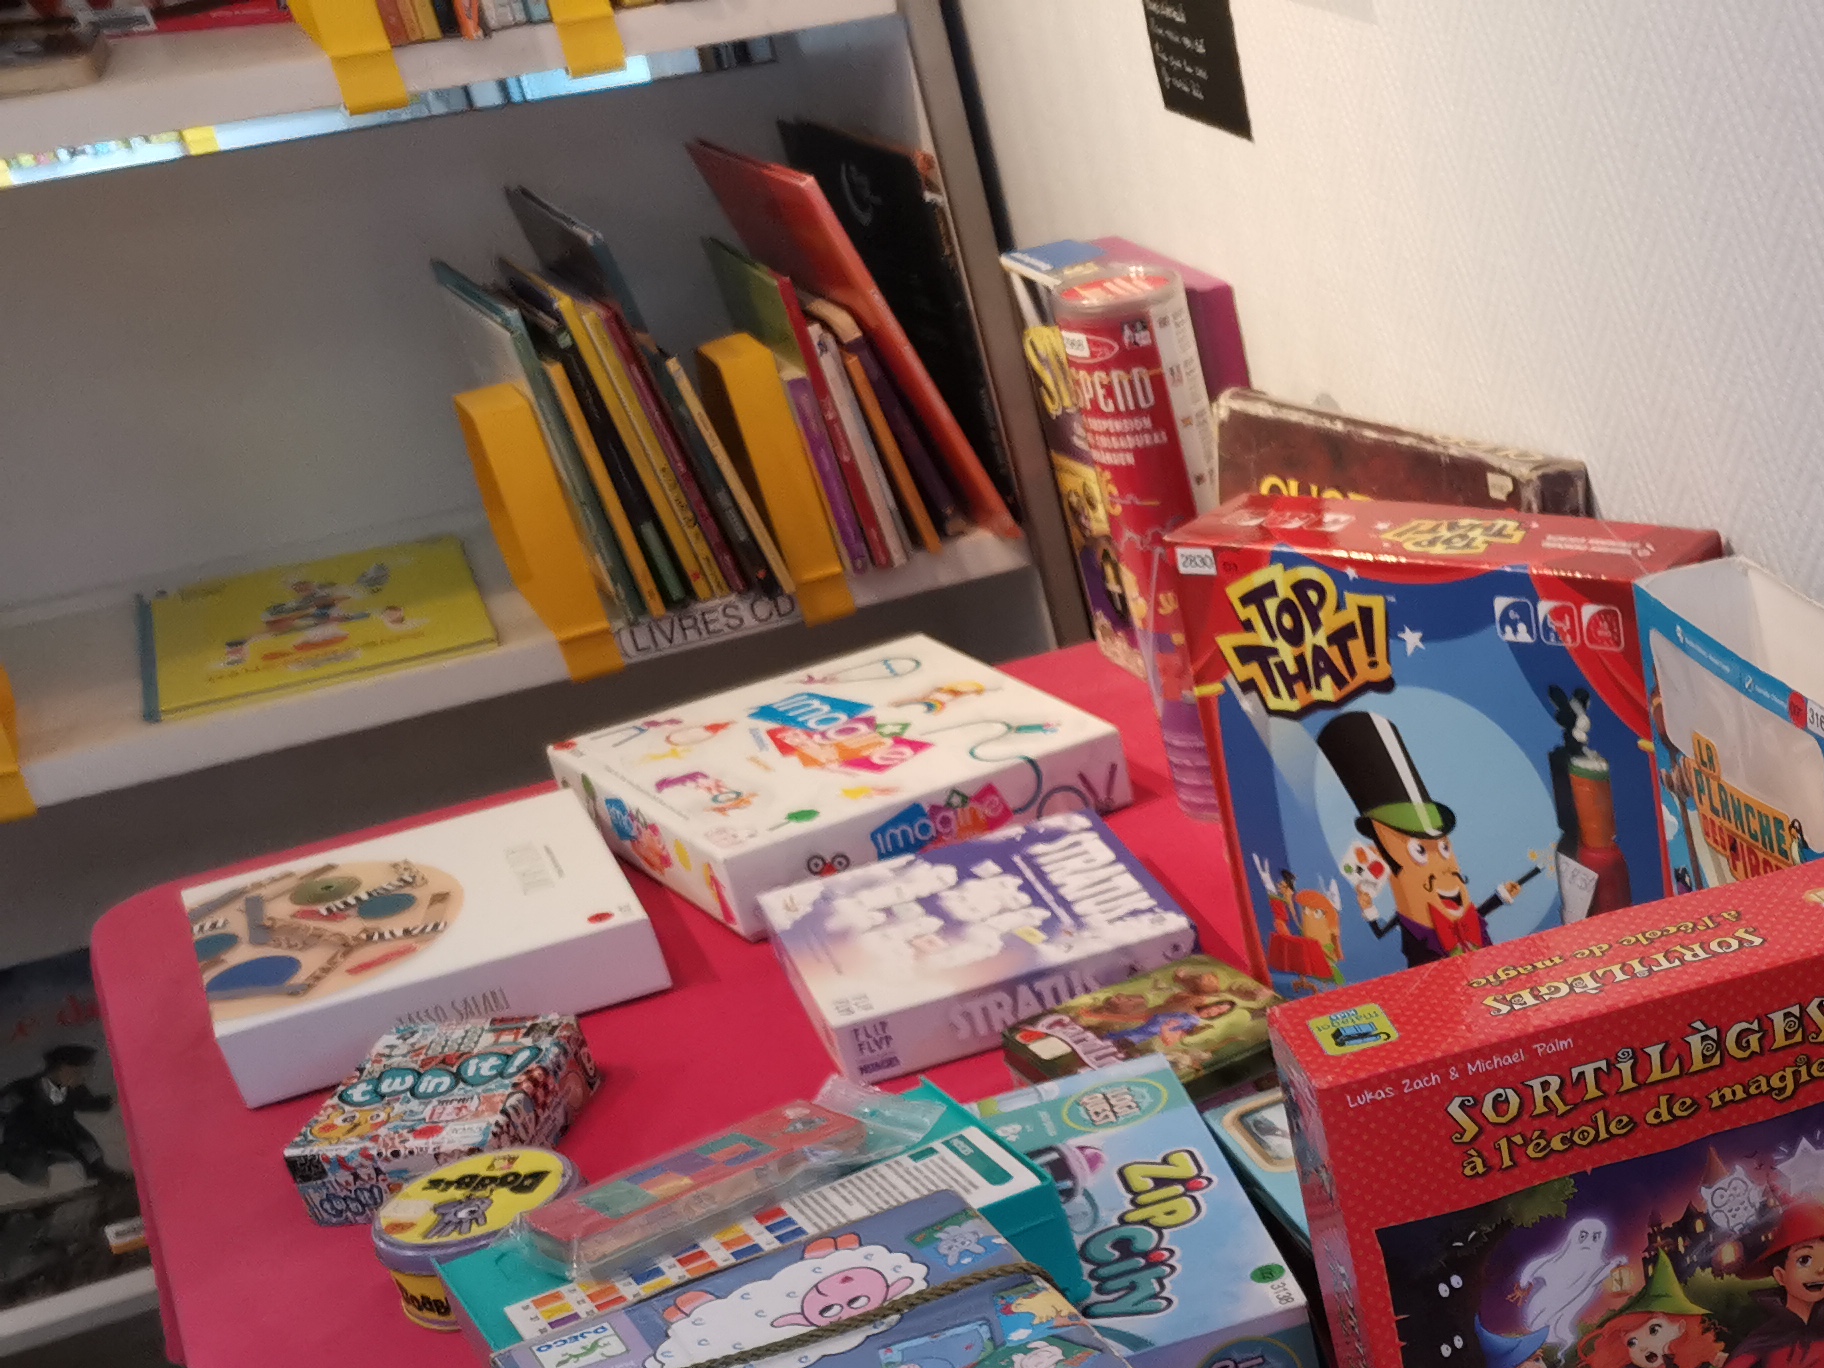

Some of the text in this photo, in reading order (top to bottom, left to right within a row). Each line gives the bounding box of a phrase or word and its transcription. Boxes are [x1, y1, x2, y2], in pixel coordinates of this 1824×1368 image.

[630, 595, 795, 652] LIVRES CD
[1239, 578, 1327, 647] TOP
[1234, 606, 1379, 701] THAT!
[1697, 739, 1717, 773] LA
[1694, 767, 1790, 861] PLANCHE
[1346, 1036, 1574, 1109] Lukas Zach & Michael Palm
[1461, 1148, 1489, 1179] à
[1495, 1110, 1637, 1172] l'école
[1645, 1092, 1701, 1128] de
[1270, 1281, 1295, 1307] 3138
[536, 1325, 608, 1353] DJECO
